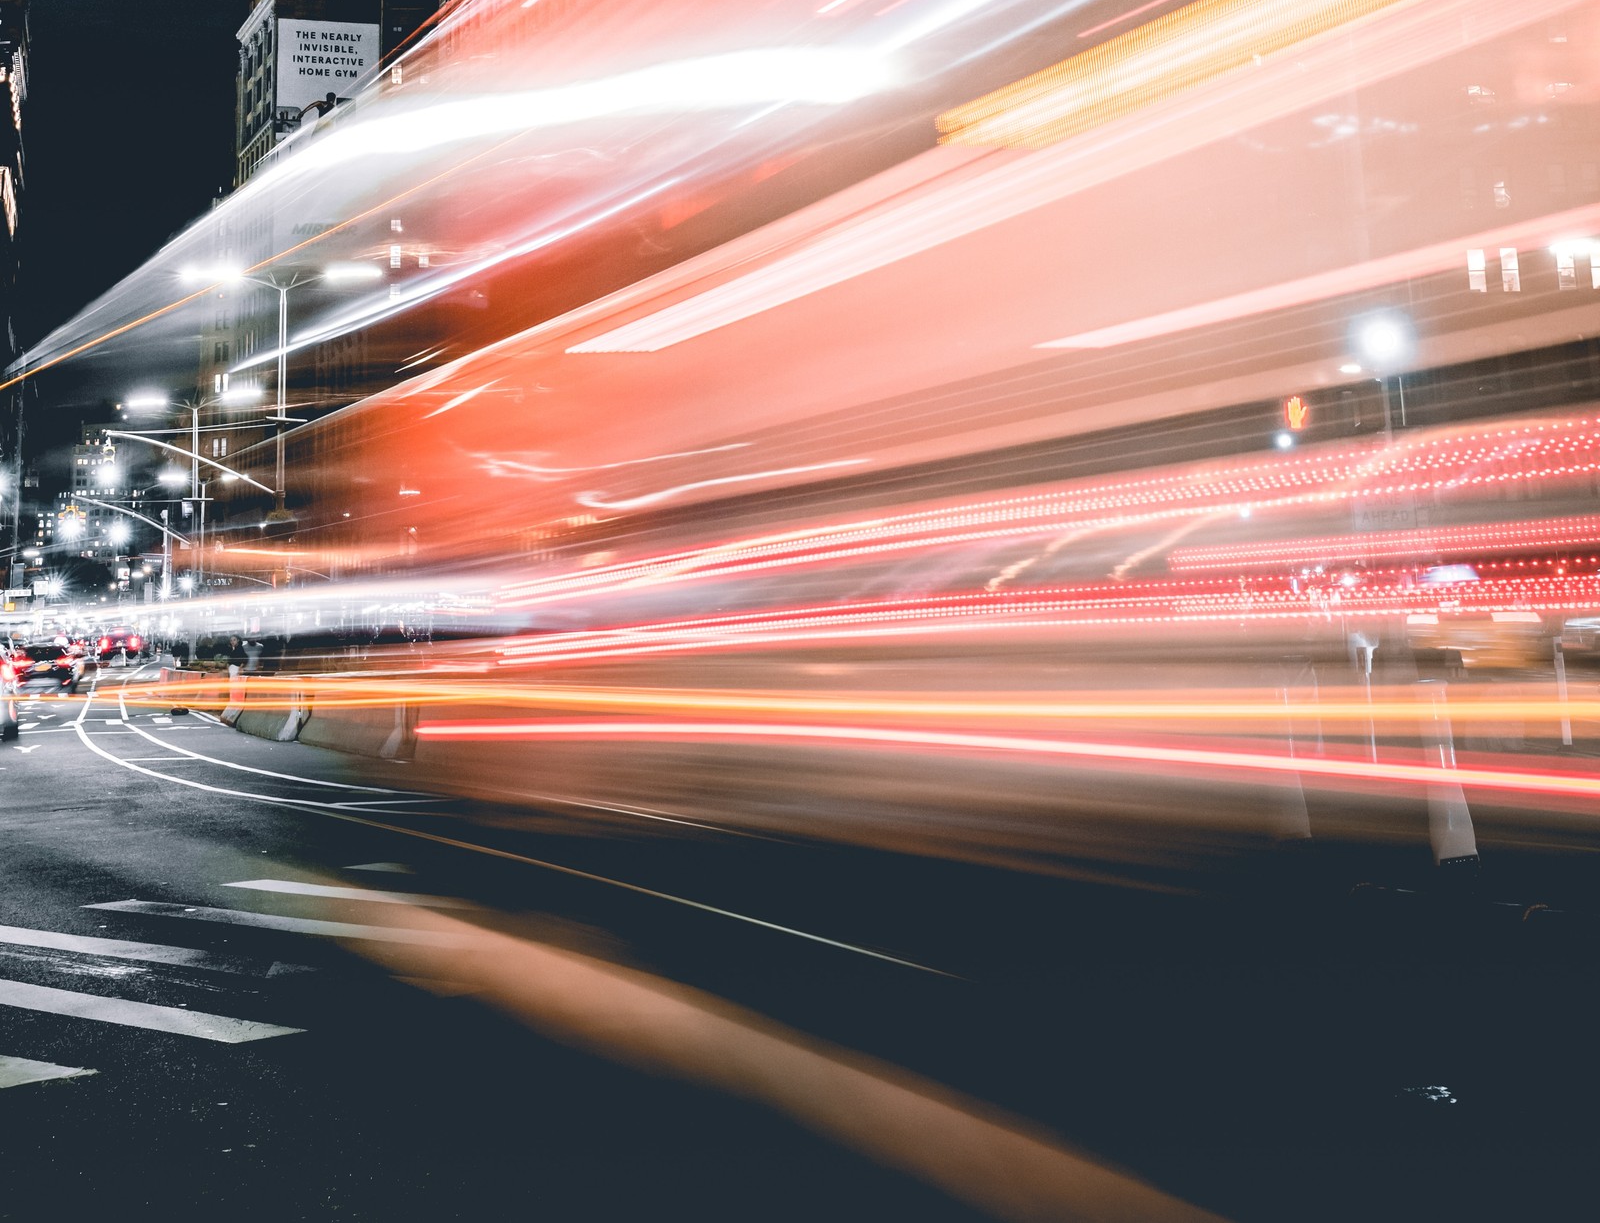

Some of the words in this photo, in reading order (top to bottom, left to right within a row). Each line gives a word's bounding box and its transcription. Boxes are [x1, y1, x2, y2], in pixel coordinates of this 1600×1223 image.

[296, 31, 316, 40] THE
[321, 32, 362, 42] NEARLY
[299, 43, 358, 55] INVISIBLE,
[292, 55, 364, 67] INTERACTIVE
[299, 67, 330, 77] HOME
[335, 69, 358, 78] GYM
[1365, 493, 1401, 506] LANE
[1362, 510, 1409, 523] AHEAD
